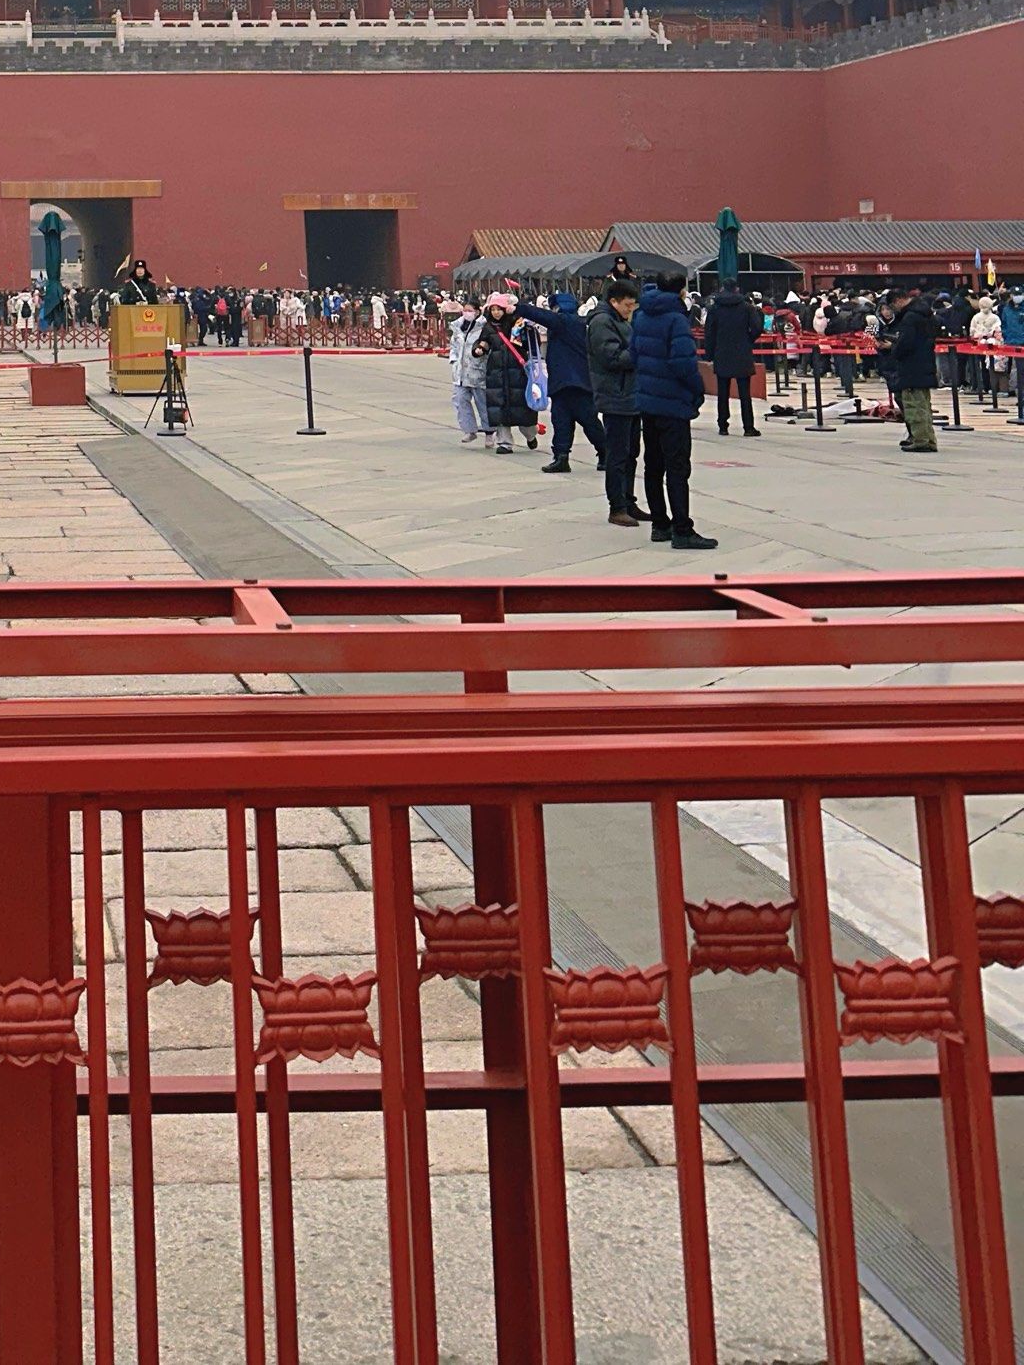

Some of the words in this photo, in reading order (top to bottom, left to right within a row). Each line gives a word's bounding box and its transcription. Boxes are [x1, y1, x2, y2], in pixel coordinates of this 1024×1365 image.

[845, 263, 857, 272] 13
[877, 263, 889, 272] 14
[950, 263, 961, 271] 15
